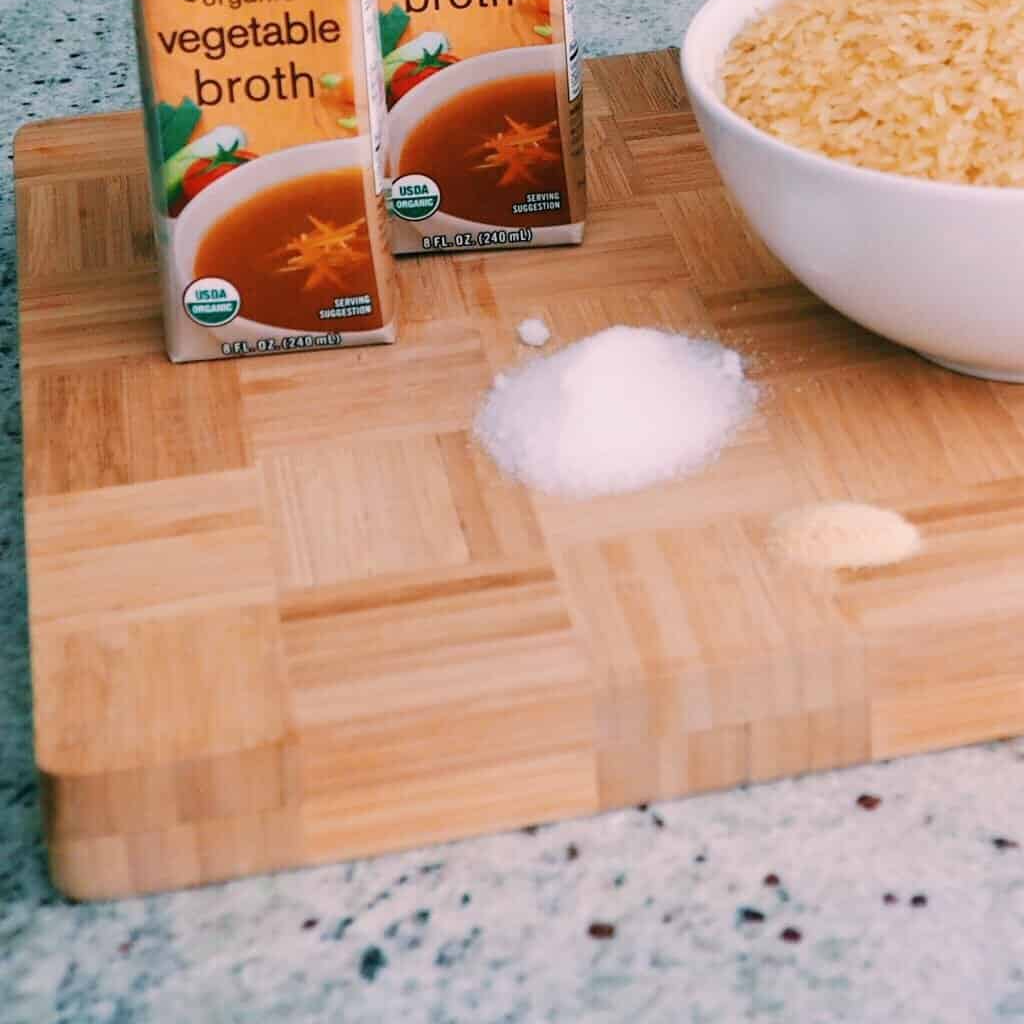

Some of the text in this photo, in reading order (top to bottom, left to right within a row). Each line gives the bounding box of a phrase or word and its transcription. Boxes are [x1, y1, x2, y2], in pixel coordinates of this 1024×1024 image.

[157, 9, 341, 60] vegetable
[194, 61, 314, 107] broth
[399, 184, 430, 197] USDA
[396, 198, 434, 210] ORGANIC
[526, 192, 561, 203] SERVING
[512, 201, 561, 215] SUGGESTION
[423, 238, 430, 249] 8
[478, 230, 506, 246] (240
[509, 228, 533, 243] mL)
[195, 289, 227, 300] USDA
[334, 295, 371, 307] SERVING
[319, 305, 371, 320] SUGGESTION
[223, 344, 231, 355] 8
